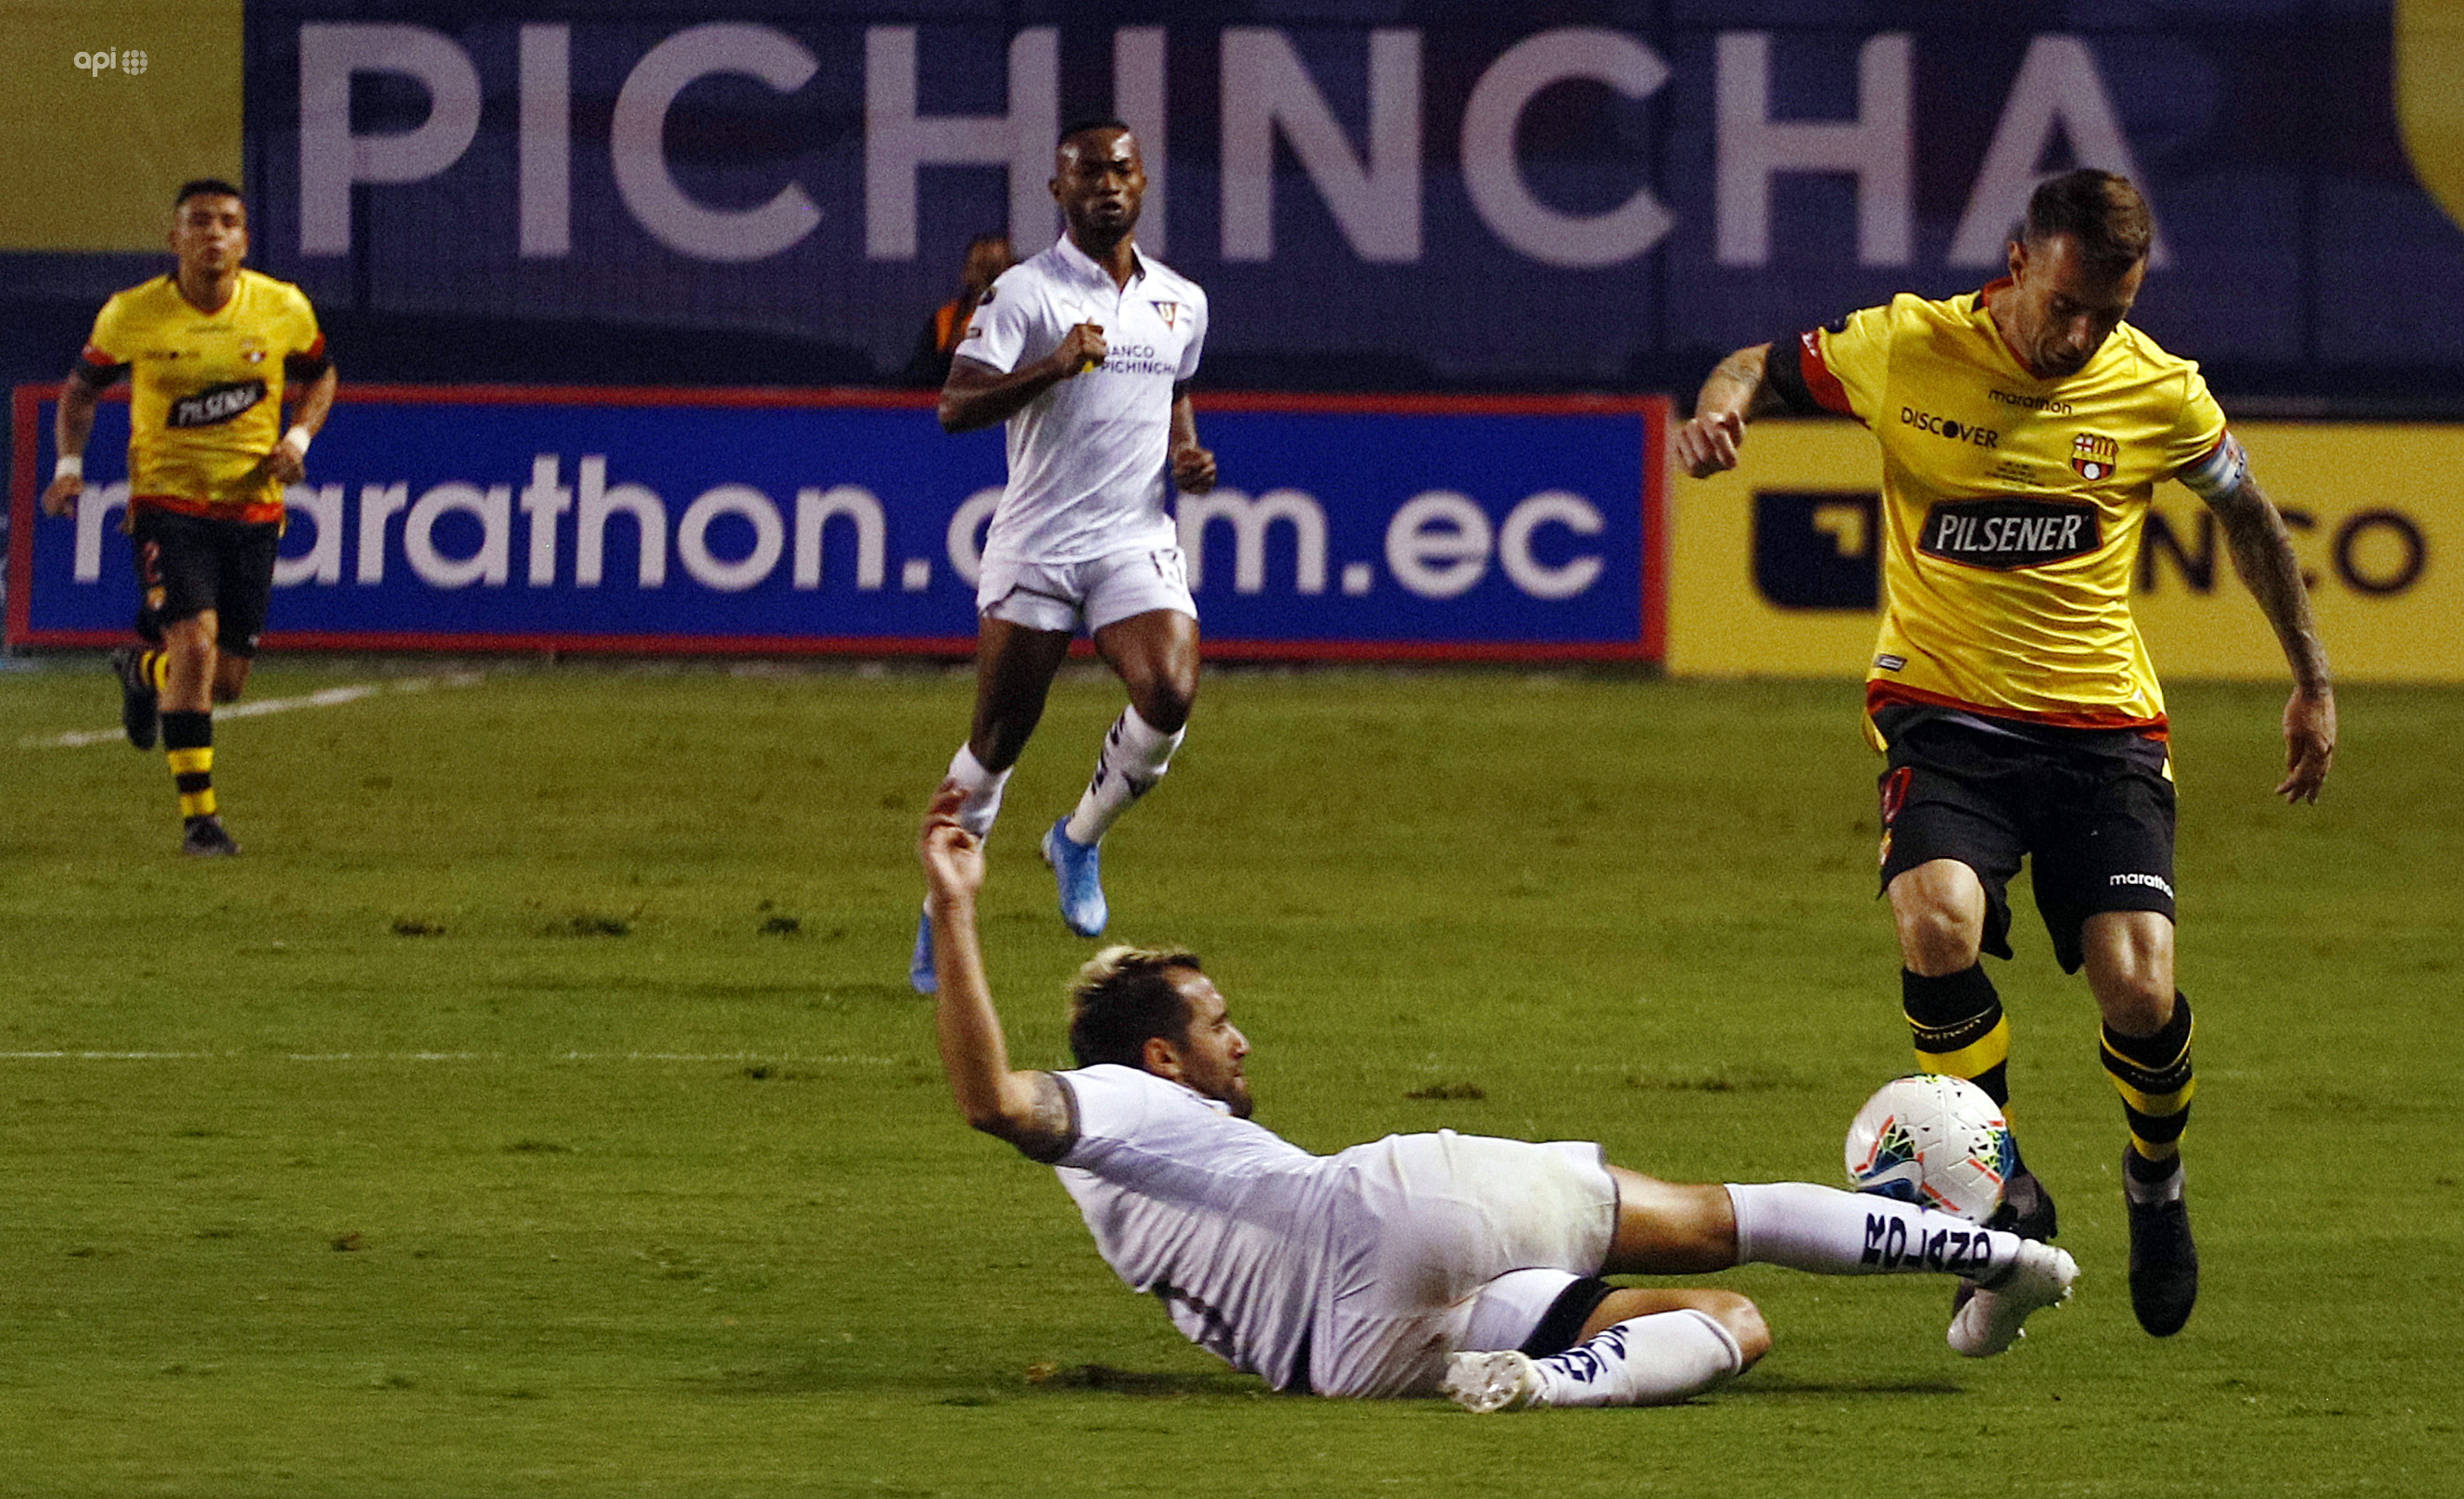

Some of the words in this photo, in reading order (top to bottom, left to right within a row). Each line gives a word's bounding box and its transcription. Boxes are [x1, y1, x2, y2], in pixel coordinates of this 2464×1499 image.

[299, 21, 2172, 269] PICHINCHA
[1988, 389, 2073, 415] marathon
[1901, 407, 2000, 448] DISCOVER
[1935, 513, 2083, 552] PILSENER
[2109, 873, 2174, 900] maratho
